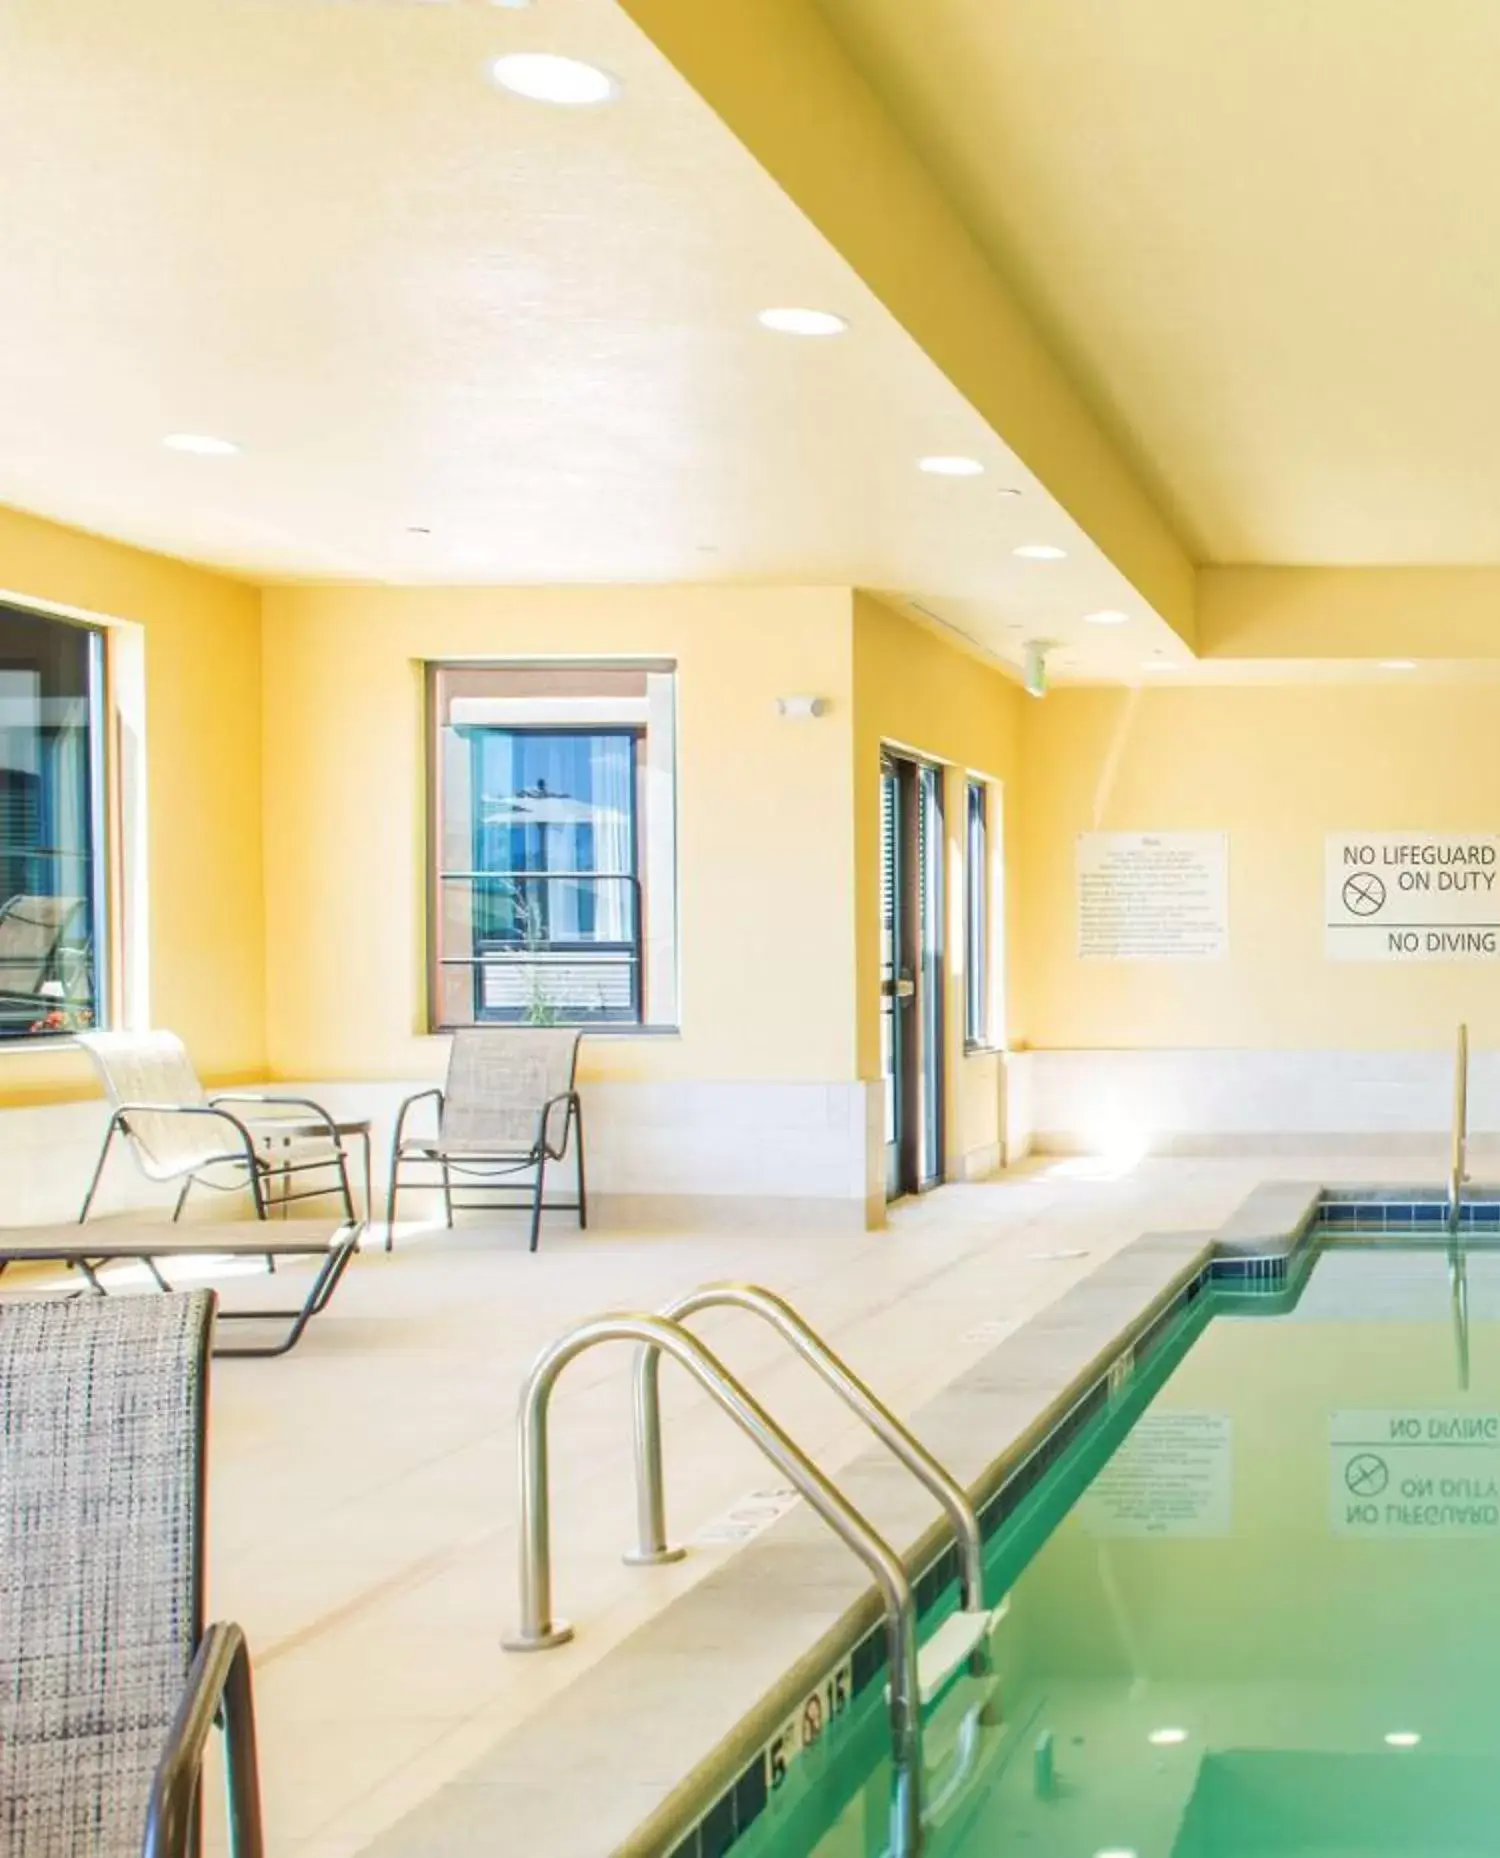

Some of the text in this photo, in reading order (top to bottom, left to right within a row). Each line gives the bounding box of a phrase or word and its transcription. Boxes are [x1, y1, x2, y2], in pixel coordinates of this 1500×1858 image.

[1343, 845, 1496, 865] NO LIFEGUARD
[1398, 871, 1496, 891] ON DUTY
[1388, 932, 1496, 952] NO DIVING
